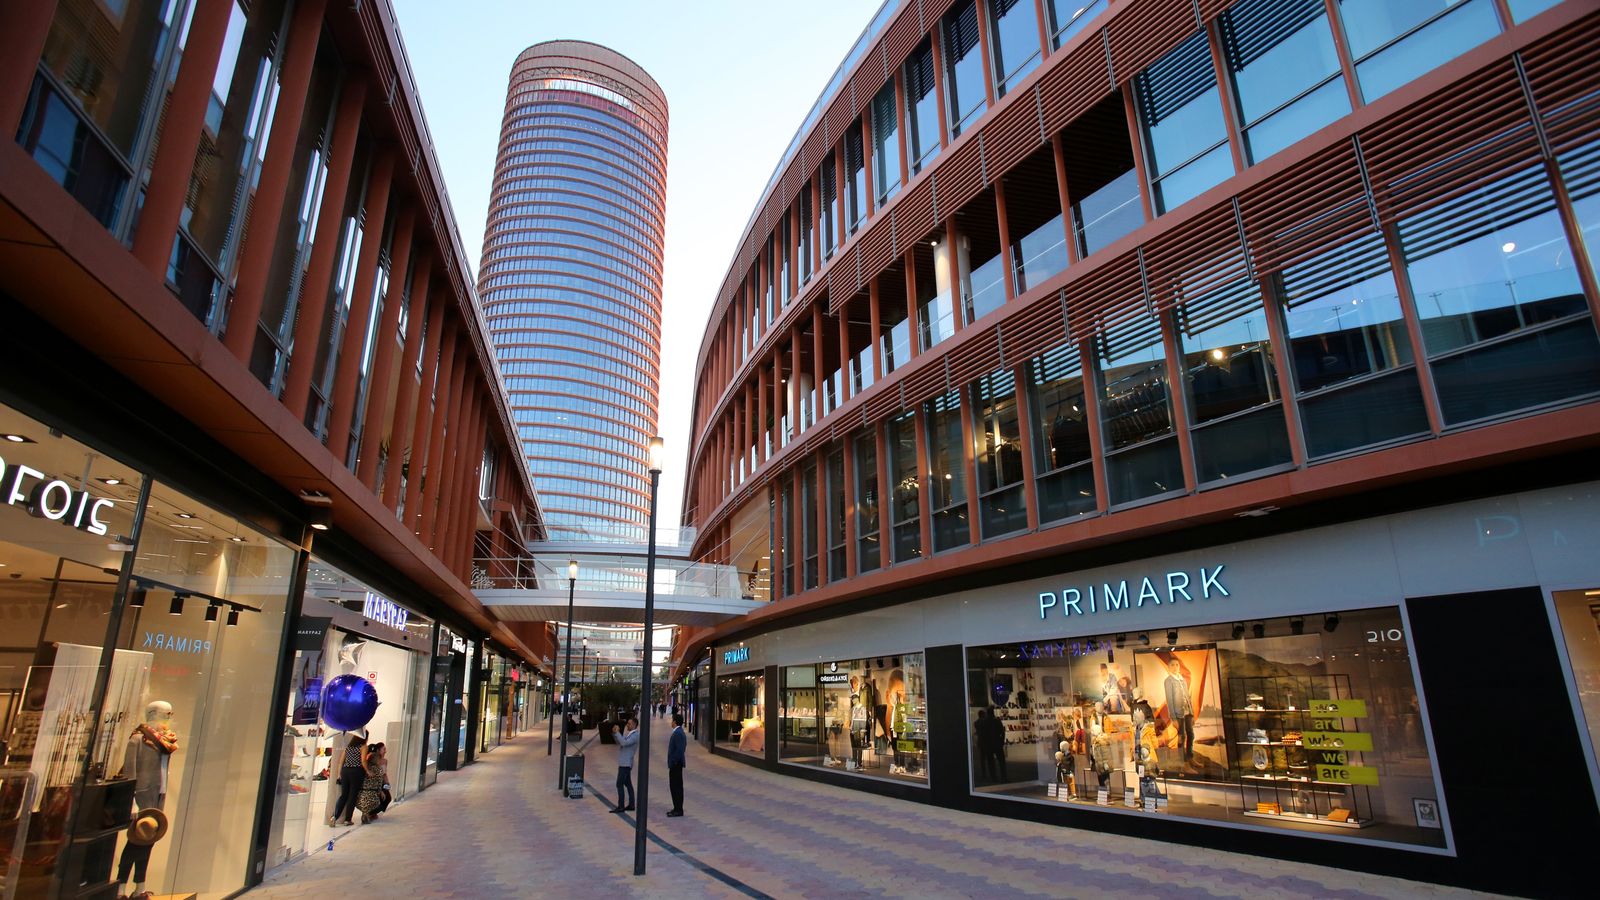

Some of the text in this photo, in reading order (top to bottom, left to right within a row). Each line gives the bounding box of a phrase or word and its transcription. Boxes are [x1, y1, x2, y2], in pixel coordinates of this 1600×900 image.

[0, 456, 114, 535] FOIS
[1039, 565, 1230, 619] PRIMARK
[363, 591, 408, 632] MARYPAZ
[724, 647, 750, 665] PRIMARK
[1315, 719, 1341, 731] are
[1308, 734, 1344, 748] who
[1322, 752, 1345, 764] we
[1323, 768, 1351, 780] are
